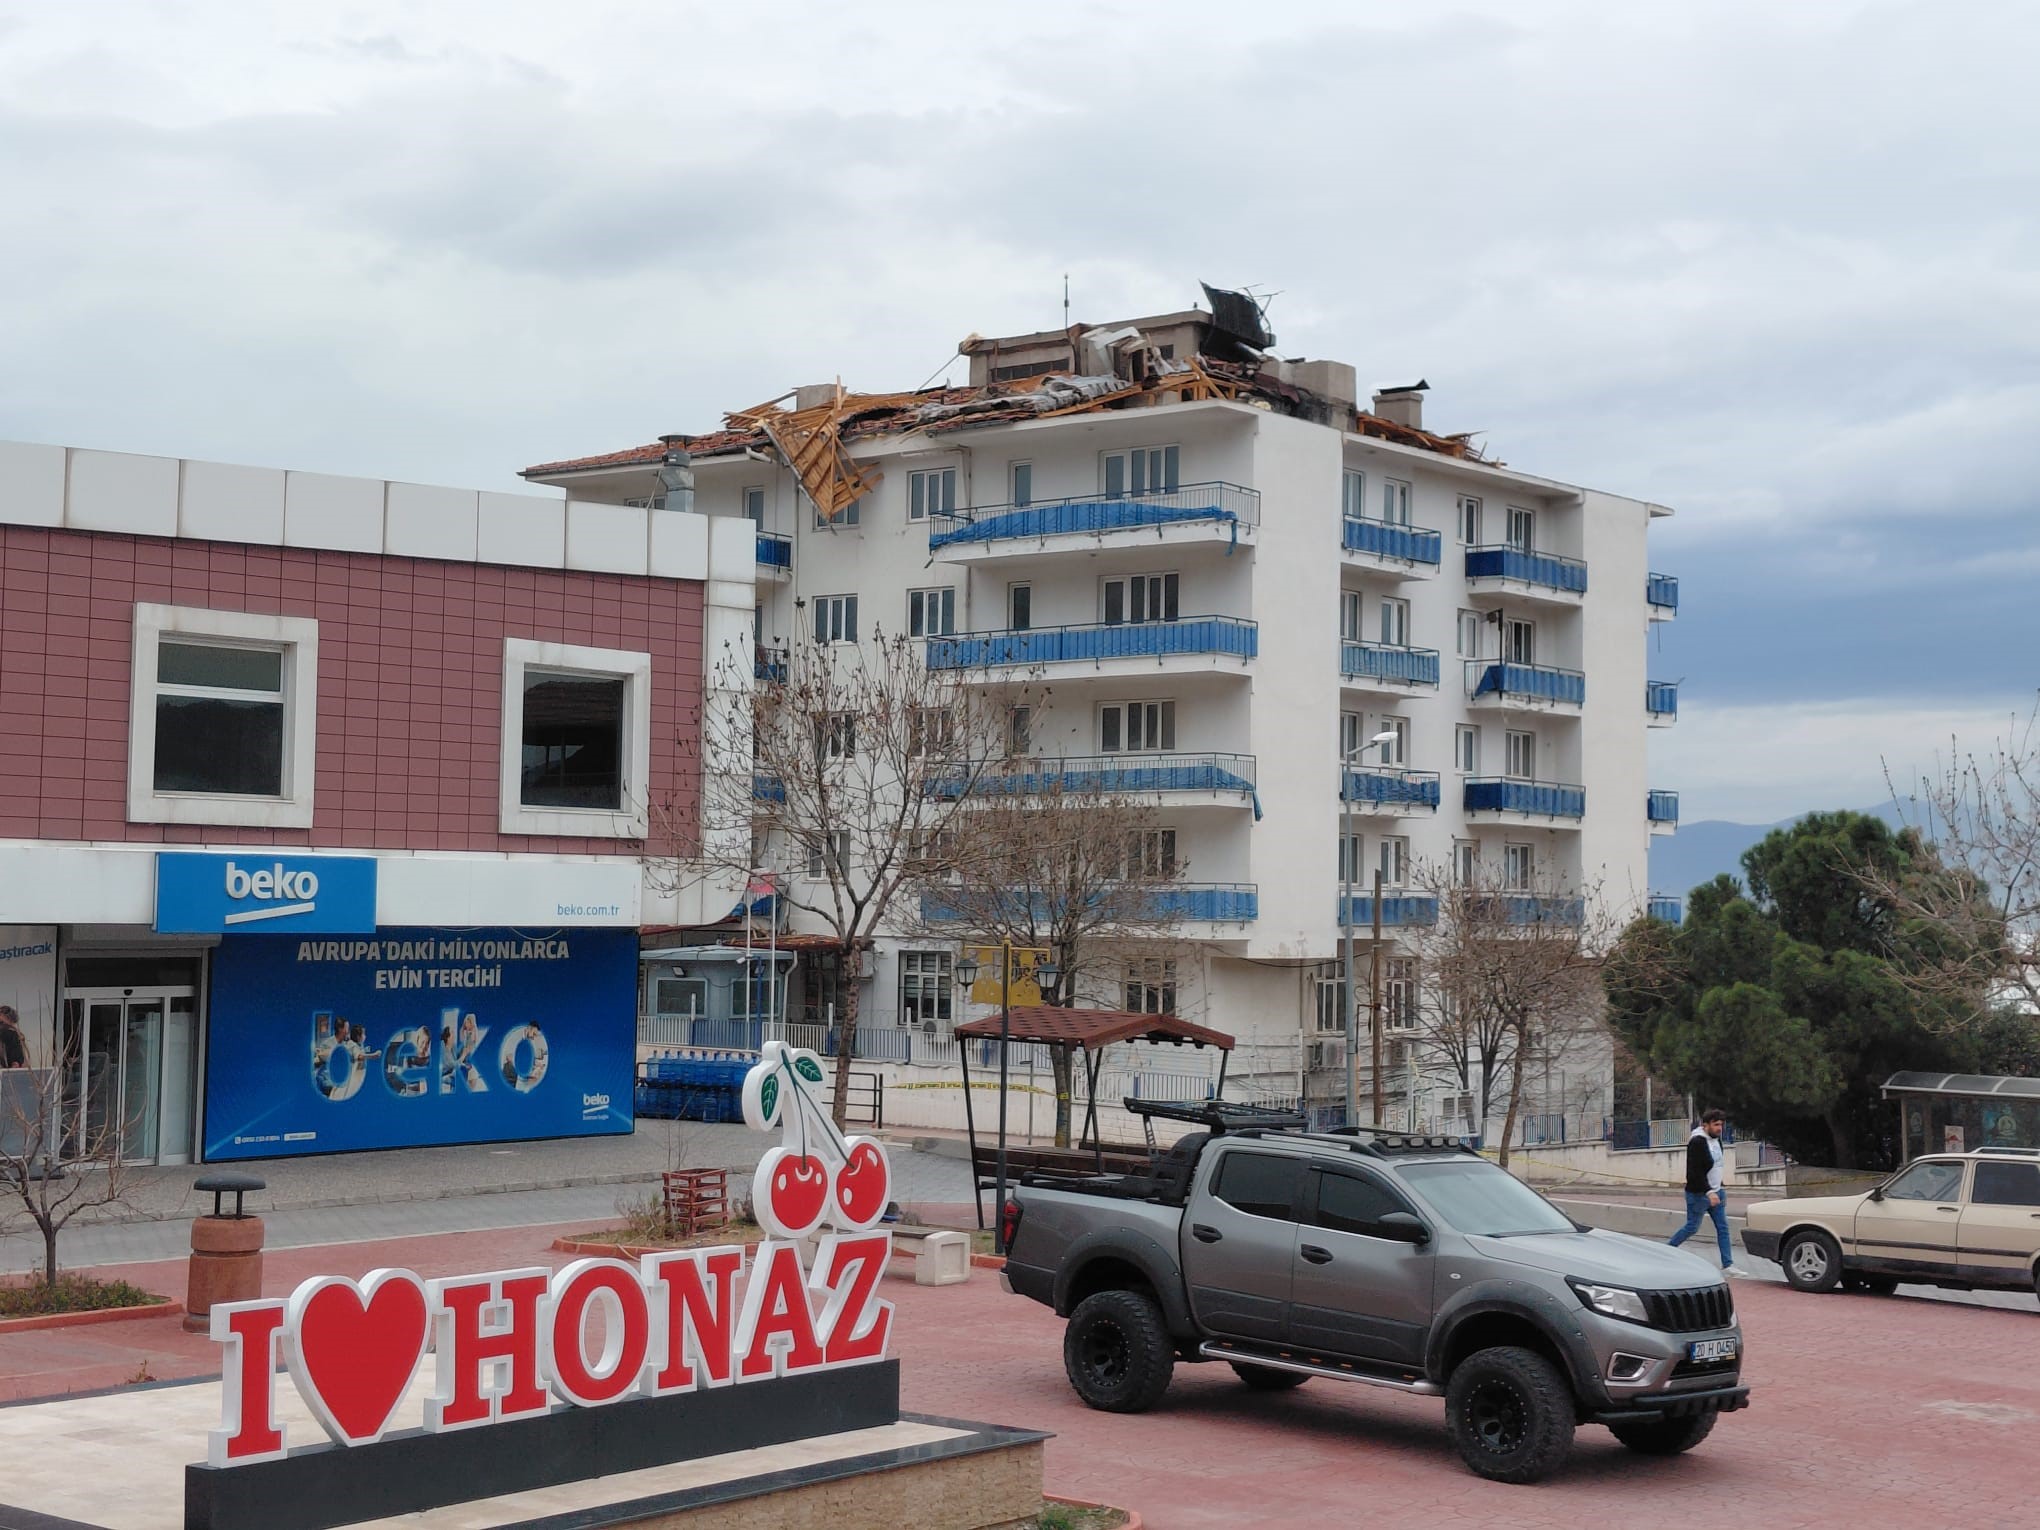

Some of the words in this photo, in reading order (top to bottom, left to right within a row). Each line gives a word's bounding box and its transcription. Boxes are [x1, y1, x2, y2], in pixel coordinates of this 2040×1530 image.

[226, 861, 319, 900] beko
[557, 903, 621, 916] beko.com.tr
[439, 937, 570, 960] MİLYONLARCA
[375, 965, 422, 989] EVİN
[427, 964, 501, 988] TERCİHİ
[312, 1007, 549, 1101] beko
[583, 1092, 610, 1106] beko
[220, 1302, 287, 1464] I
[434, 1232, 893, 1430] HONAZ
